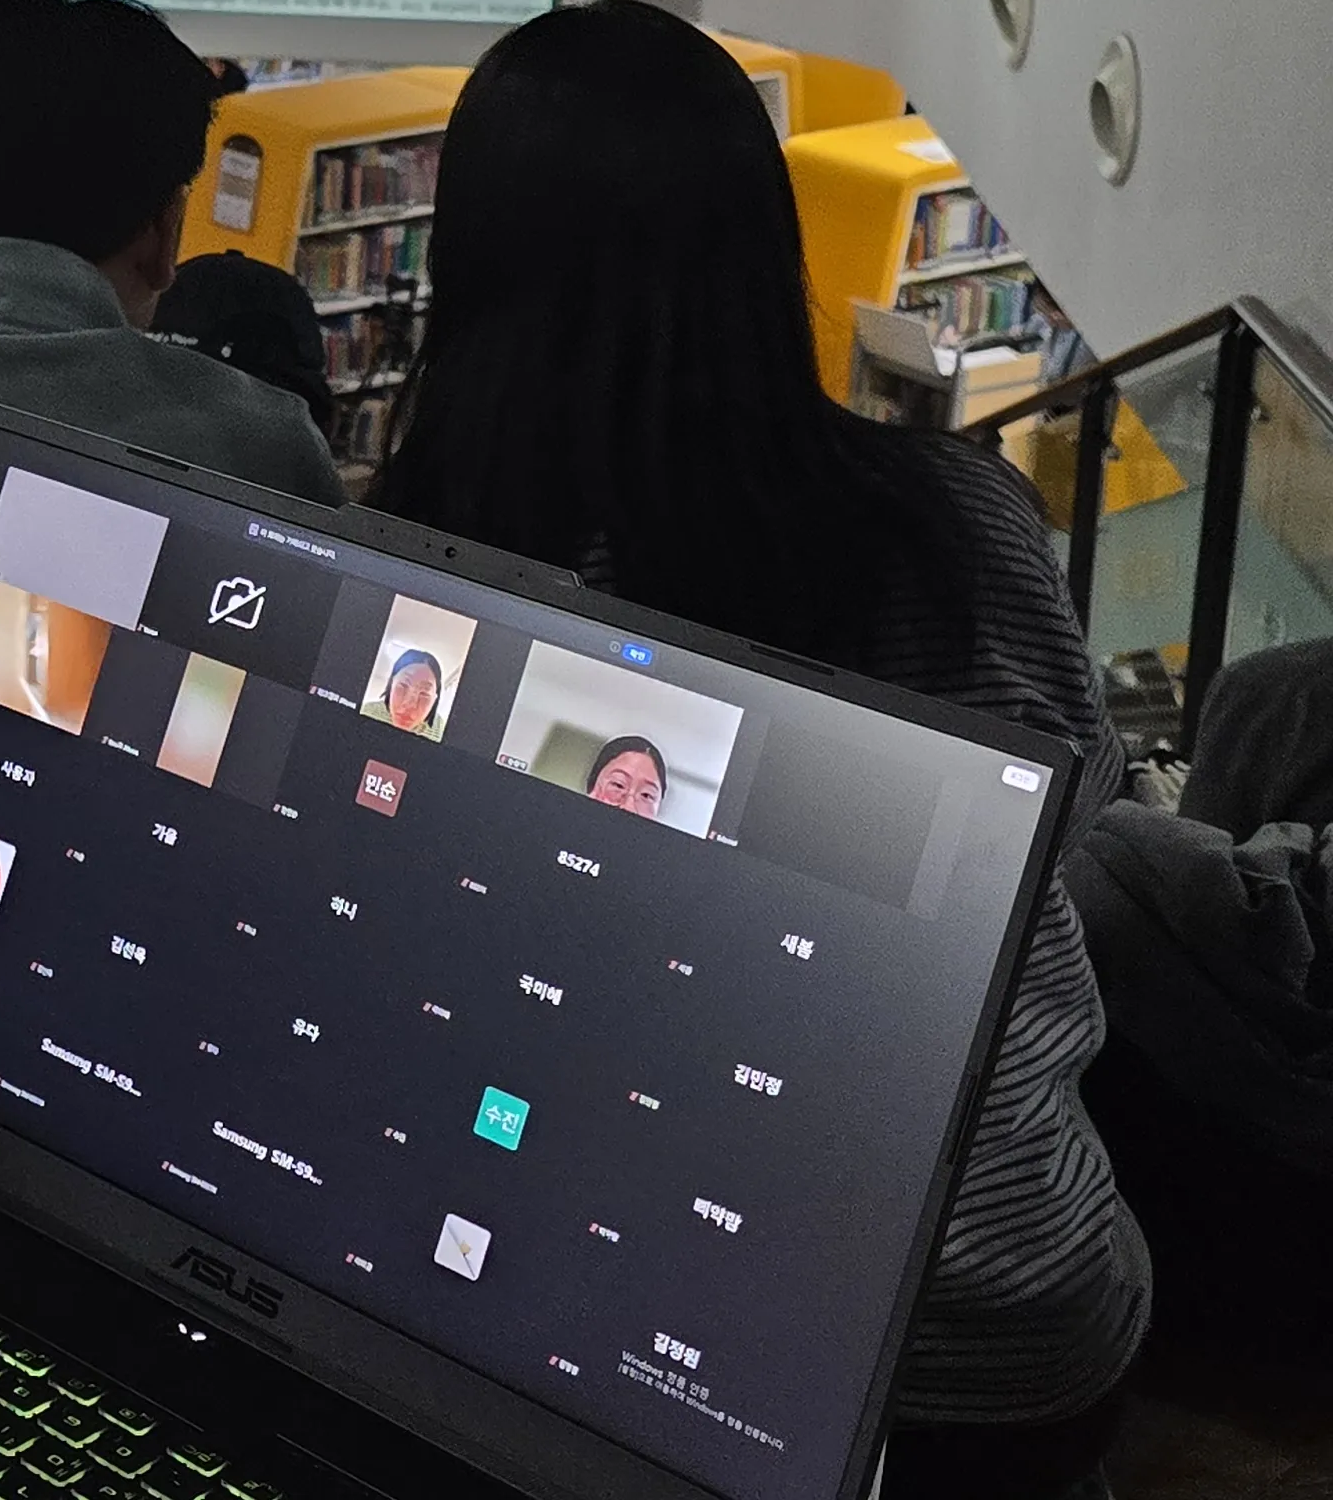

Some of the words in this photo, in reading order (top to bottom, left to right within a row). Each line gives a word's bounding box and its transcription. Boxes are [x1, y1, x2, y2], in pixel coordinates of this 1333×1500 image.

[0, 759, 36, 788] 사용자
[364, 773, 397, 803] 민순
[555, 849, 601, 878] 85274
[780, 932, 816, 961] 새봄
[40, 1036, 92, 1075] Samsung
[733, 1062, 784, 1097] 김민정
[485, 1103, 521, 1135] 수진
[211, 1119, 269, 1162] Samsung
[169, 1245, 285, 1320] ASUS
[653, 1331, 703, 1370] 김정원
[621, 1349, 665, 1380] Windows
[665, 1370, 688, 1391] 정품
[689, 1381, 710, 1401] 인증
